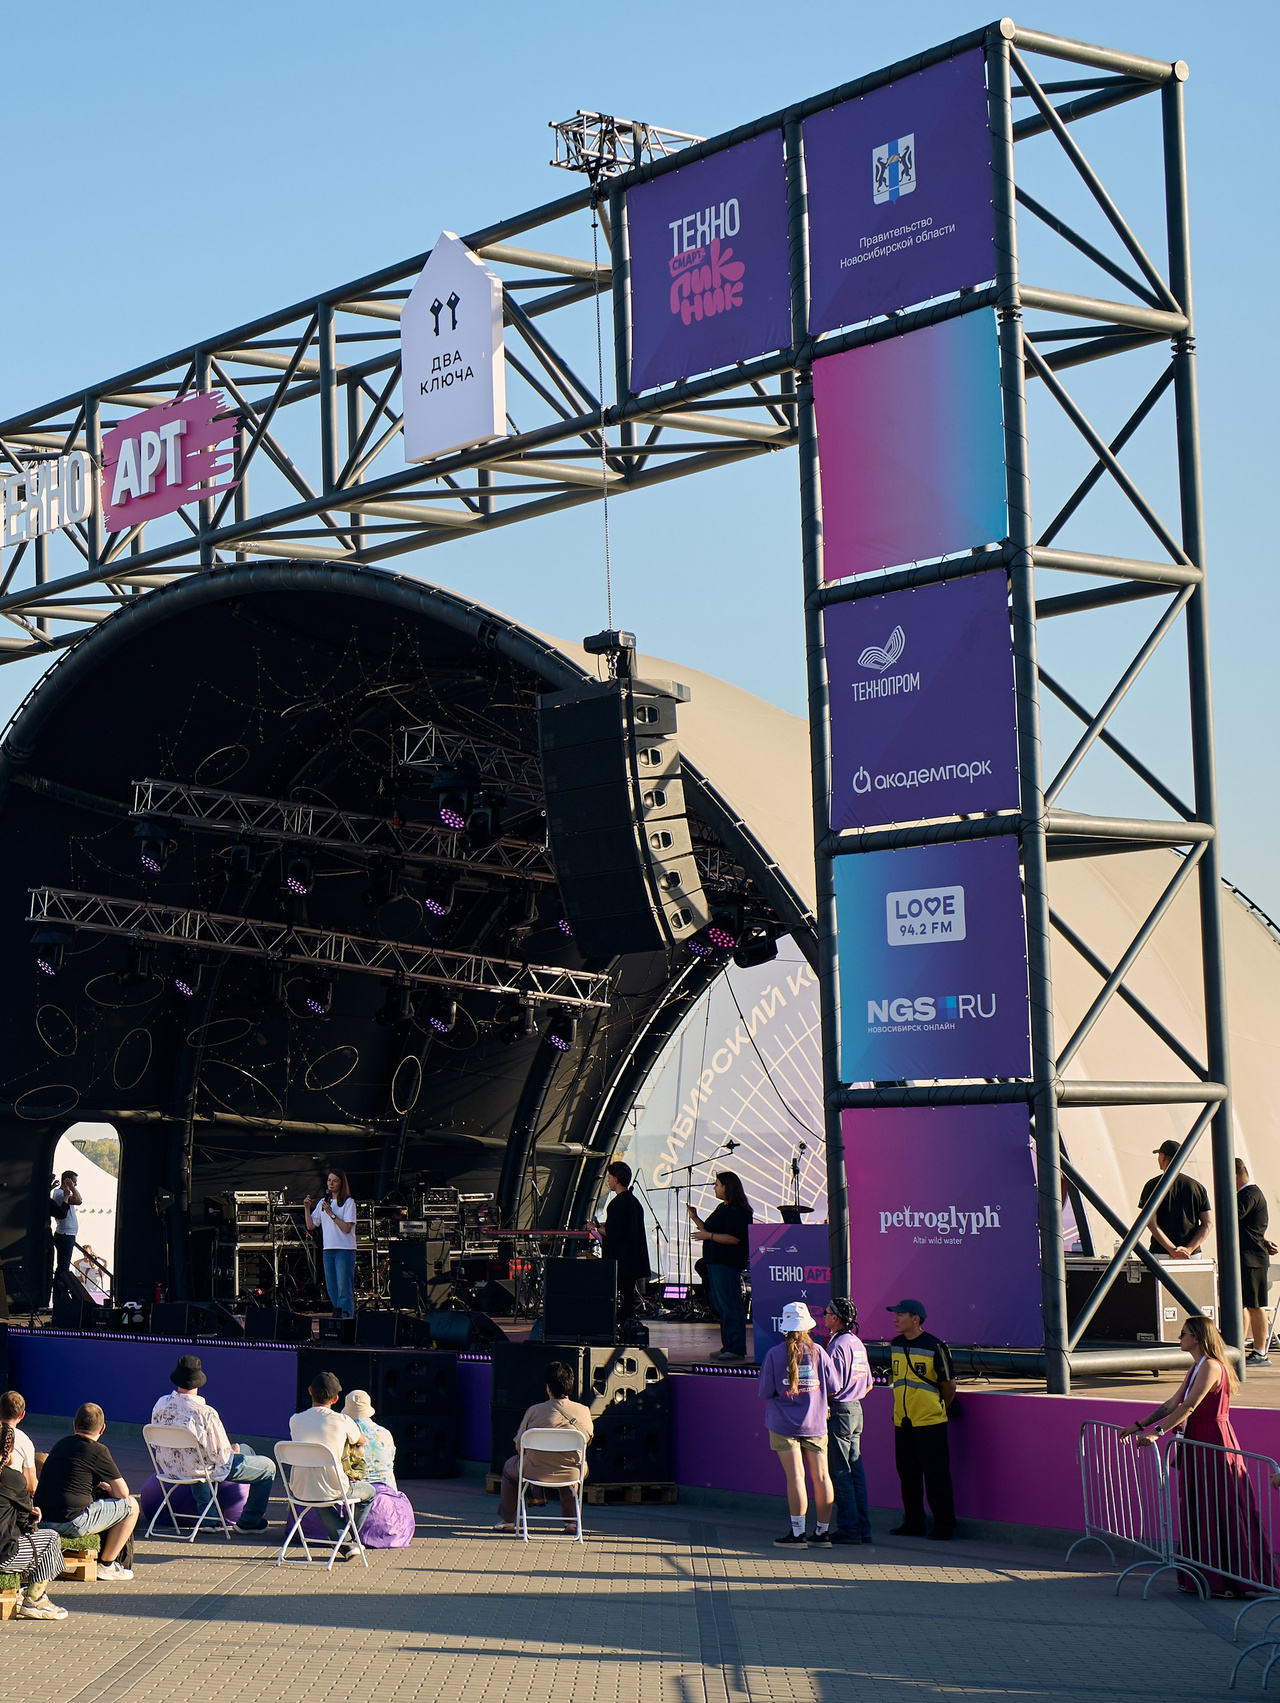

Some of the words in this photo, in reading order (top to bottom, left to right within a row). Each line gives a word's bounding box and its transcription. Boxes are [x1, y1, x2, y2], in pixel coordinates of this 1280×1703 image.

[669, 198, 740, 257] ТЕХНО
[859, 217, 933, 248] Правительство
[840, 236, 913, 269] Новосибирской
[915, 223, 956, 244] области
[431, 350, 462, 374] ДВА
[420, 366, 474, 395] КЛЮЧА
[110, 418, 188, 507] АРТ
[851, 671, 920, 701] ТЕХНОПРОМ
[874, 759, 992, 789] академпарк
[900, 923, 927, 936] 94.2
[931, 921, 952, 934] FM
[867, 1024, 922, 1034] НОВОСИБИРСК
[923, 1022, 956, 1032] ОНЛАЙН
[652, 984, 787, 1188] СИБИРСКИЙ
[913, 1236, 927, 1244] Altai
[928, 1236, 942, 1244] wild
[769, 1265, 804, 1282] ТЕХНО
[807, 1268, 828, 1281] АРТ
